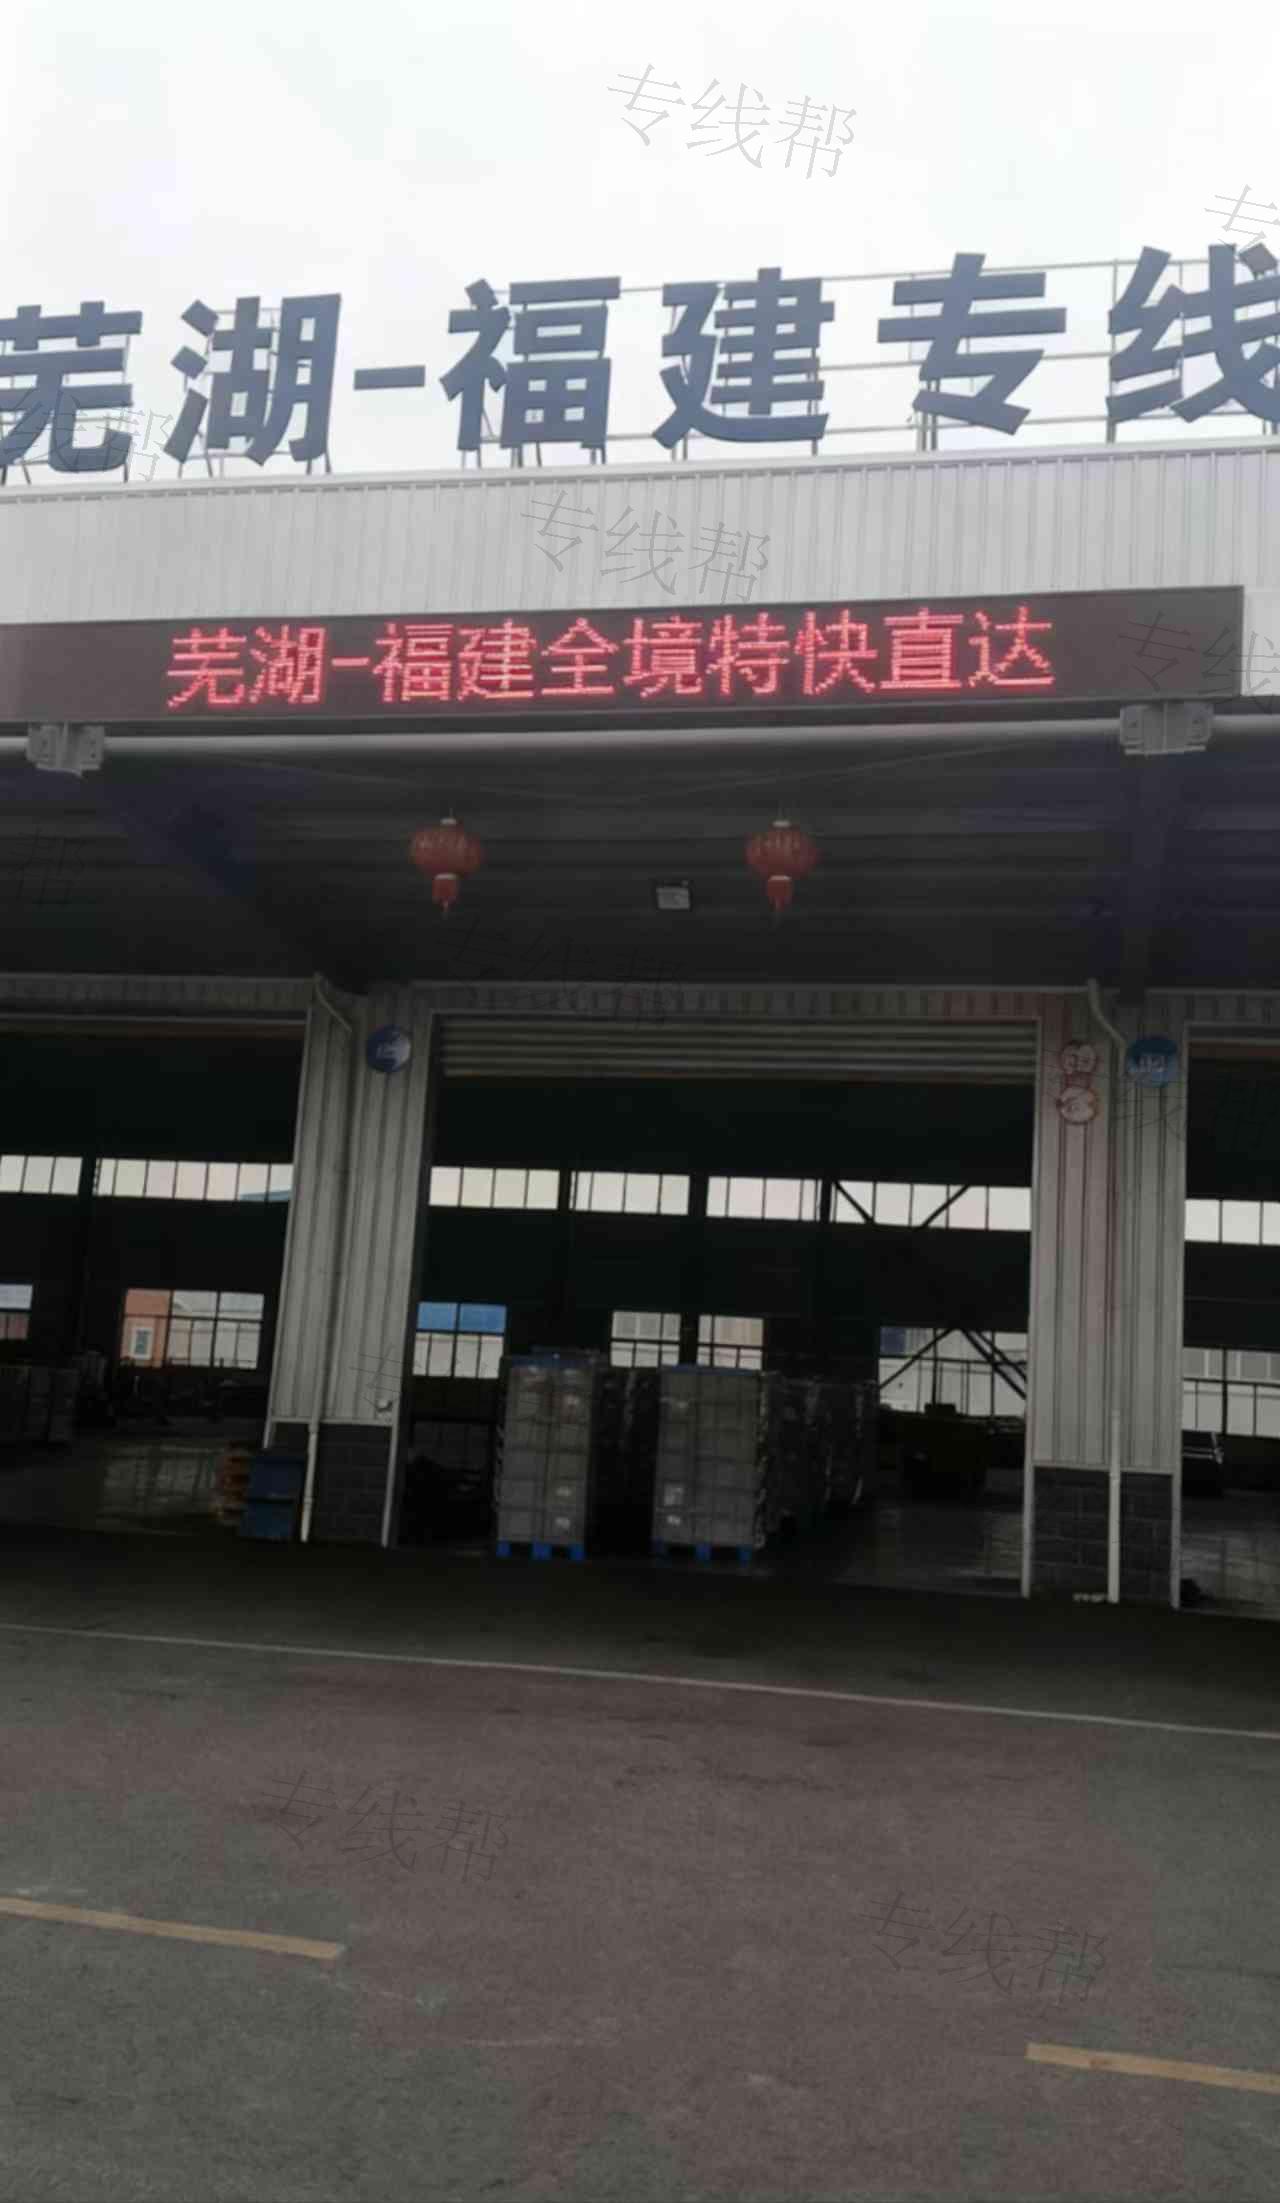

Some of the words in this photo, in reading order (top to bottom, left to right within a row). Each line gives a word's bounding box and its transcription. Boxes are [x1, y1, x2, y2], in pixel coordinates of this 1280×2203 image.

[166, 603, 1056, 709] 芜湖-福建全境特快直达
